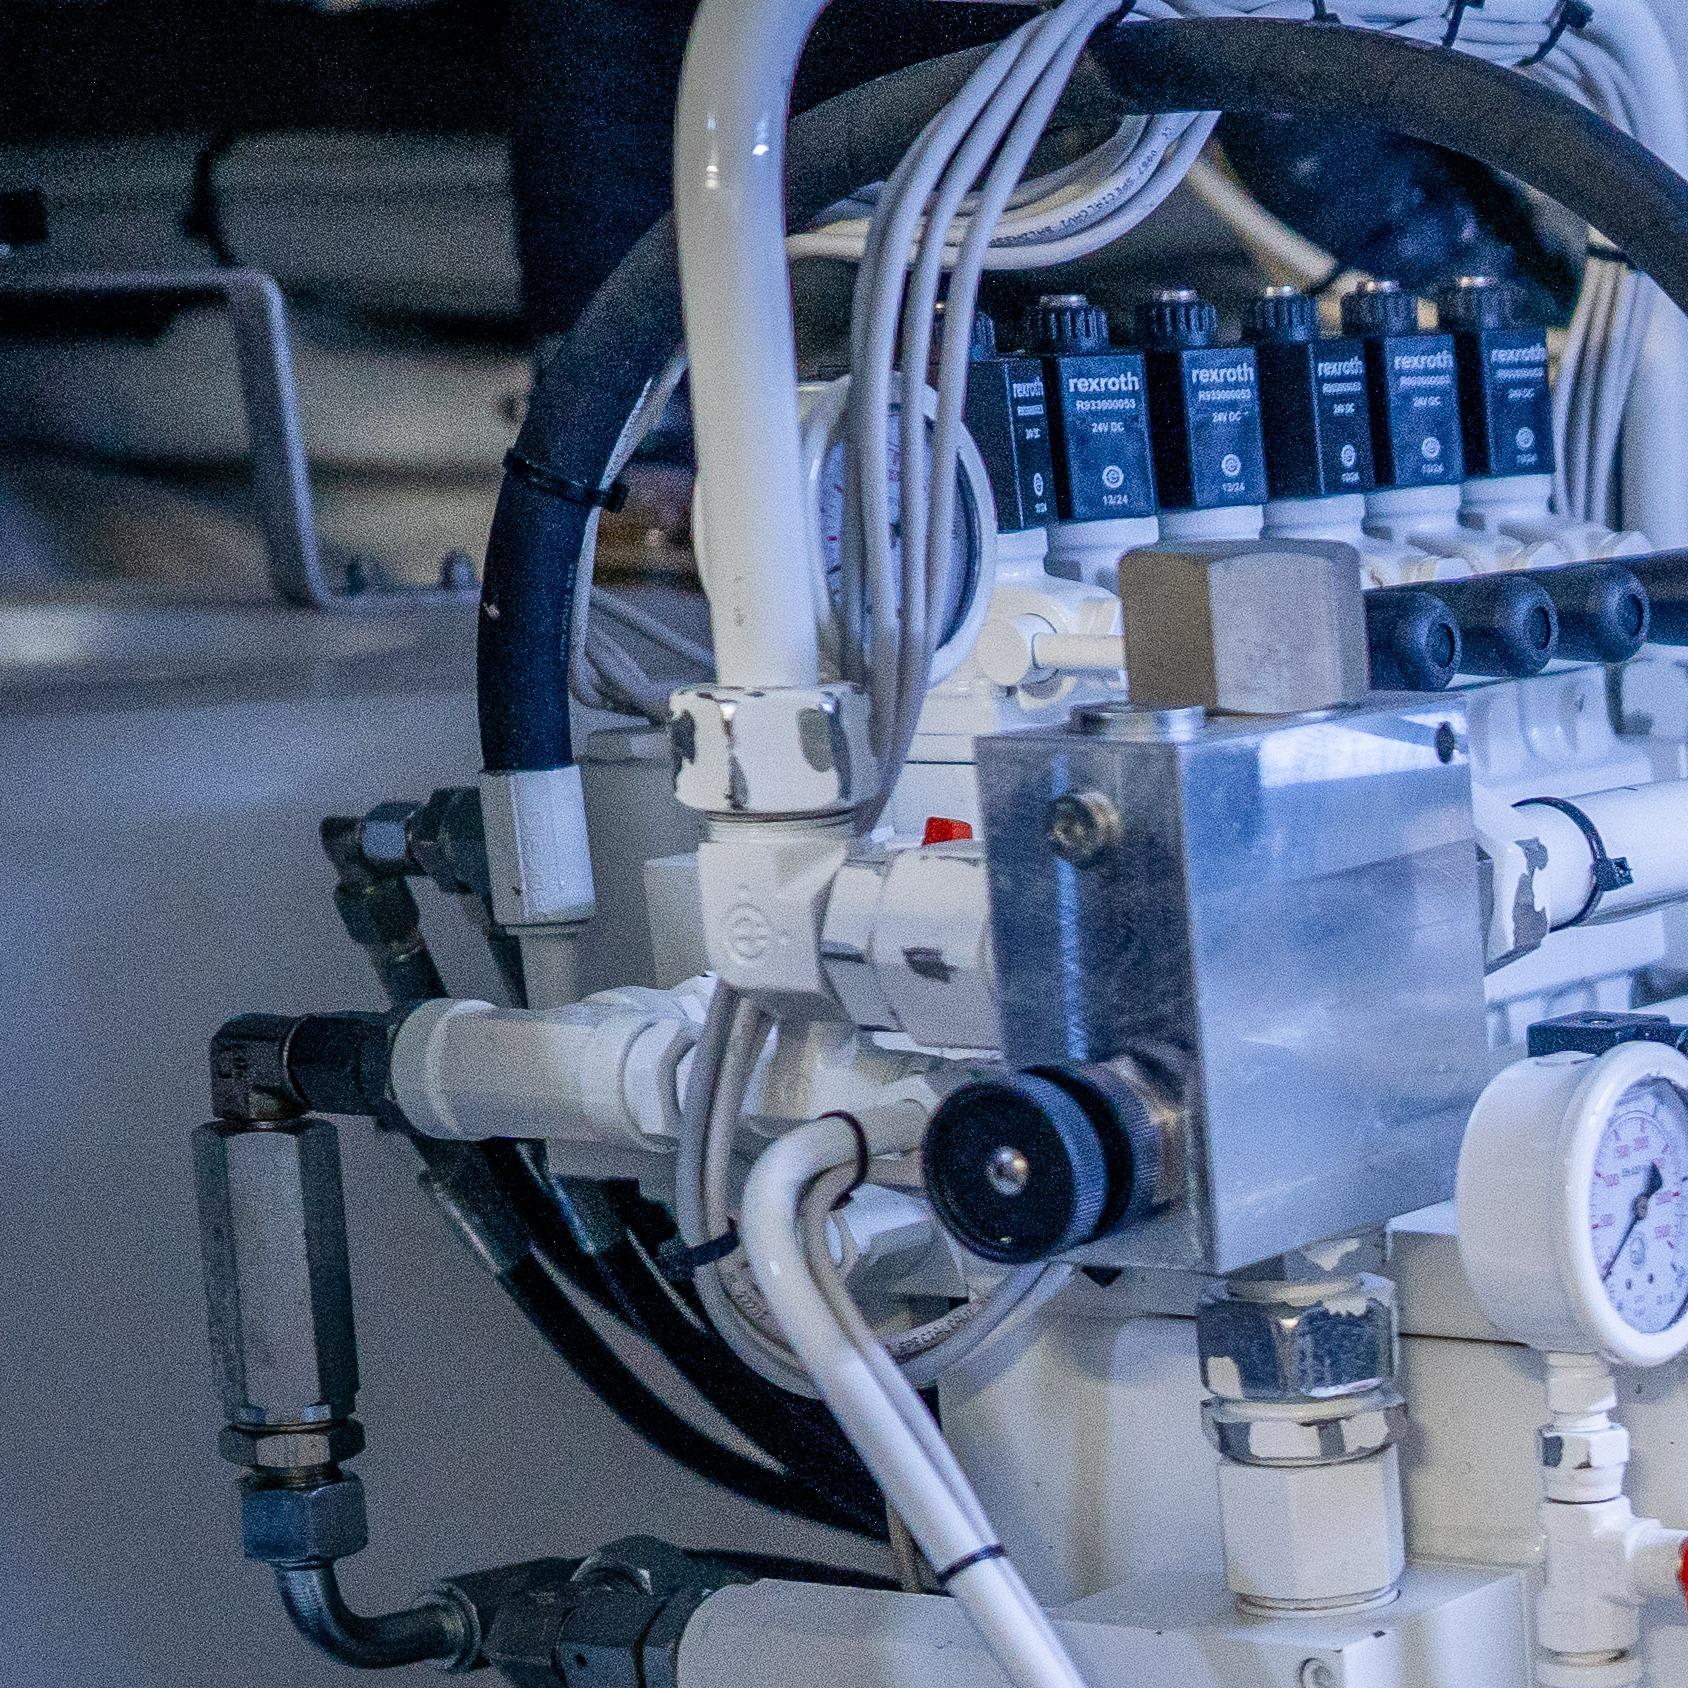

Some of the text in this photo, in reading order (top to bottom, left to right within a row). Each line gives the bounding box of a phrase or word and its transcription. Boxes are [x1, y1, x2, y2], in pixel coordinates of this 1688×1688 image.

[1394, 350, 1453, 370] rexroth
[1491, 343, 1546, 363] rexroth
[1191, 363, 1255, 383] rexroth
[1318, 355, 1363, 377] rexroth
[1068, 371, 1140, 393] rexroth
[1092, 422, 1124, 433] 24V DC
